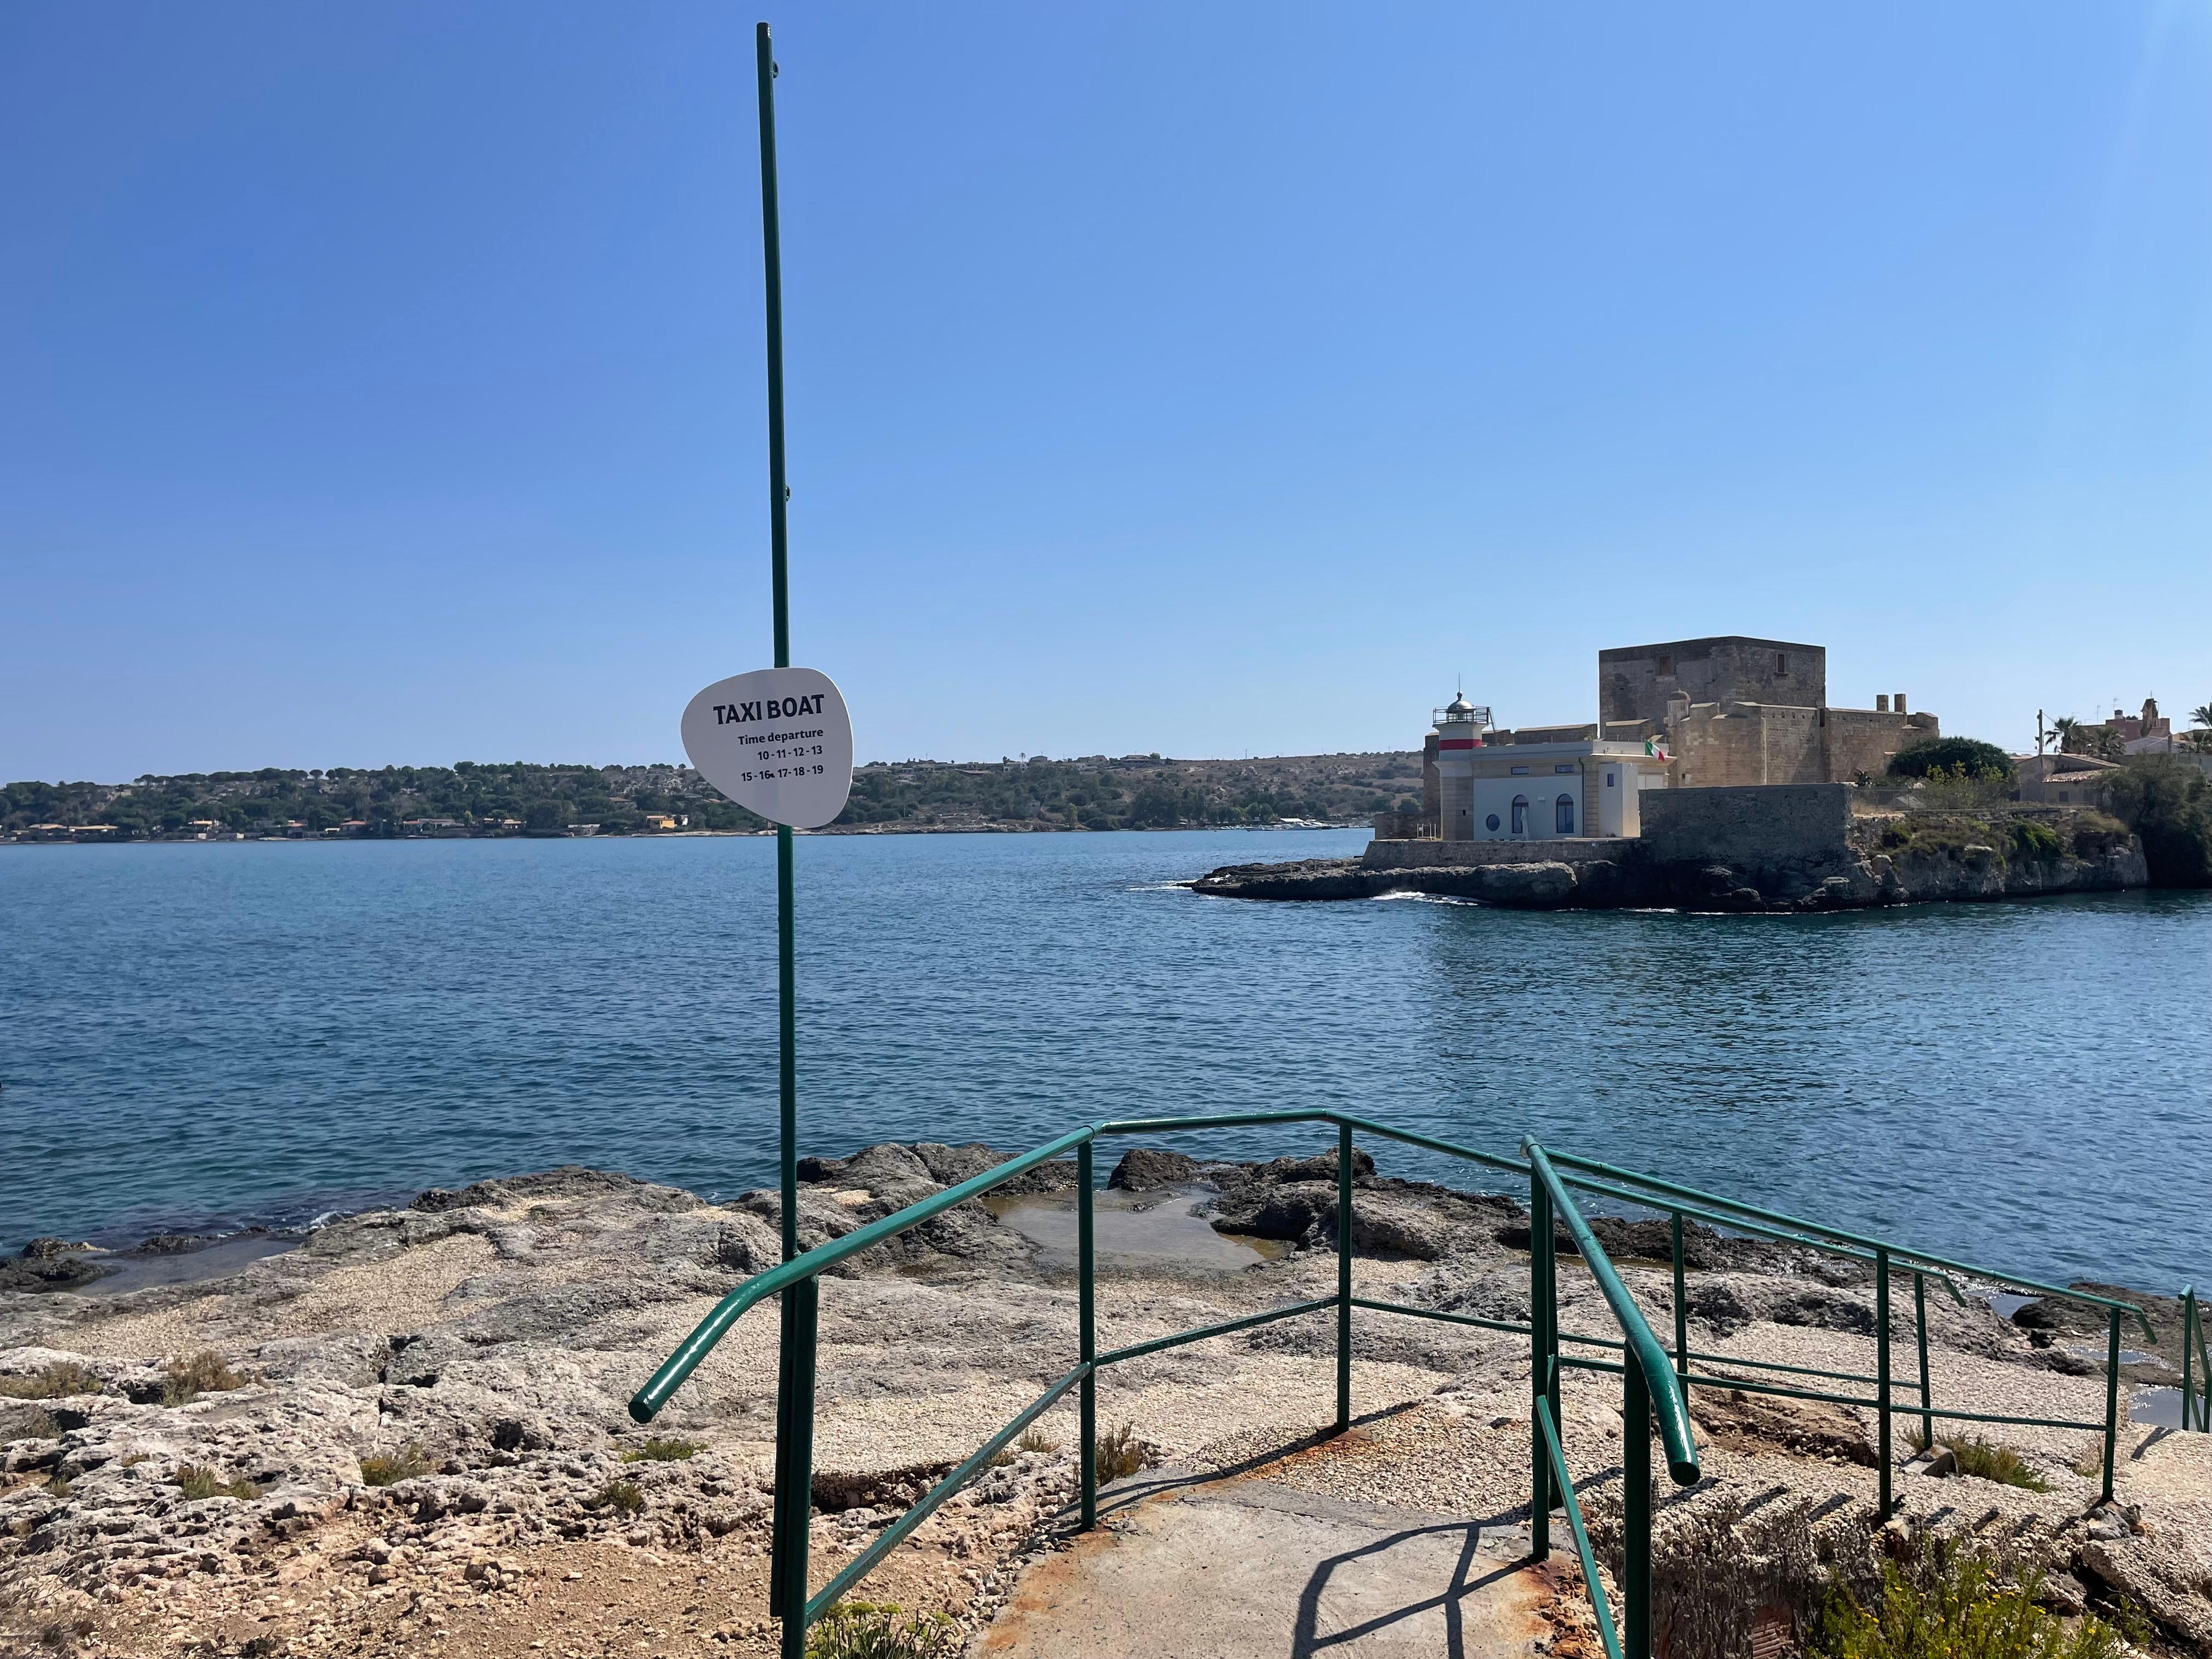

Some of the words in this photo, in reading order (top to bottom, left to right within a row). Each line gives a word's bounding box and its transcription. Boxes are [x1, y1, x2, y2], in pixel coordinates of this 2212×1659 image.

[713, 701, 763, 725] TAXI
[767, 693, 825, 720] BOAT
[737, 735, 765, 746] Time
[768, 729, 823, 743] departure
[757, 750, 769, 760] 10
[776, 749, 786, 759] 11
[793, 747, 804, 757] 12
[811, 745, 822, 755] 13
[741, 772, 752, 782] 15
[793, 766, 805, 776] 18
[811, 765, 823, 775] 19
